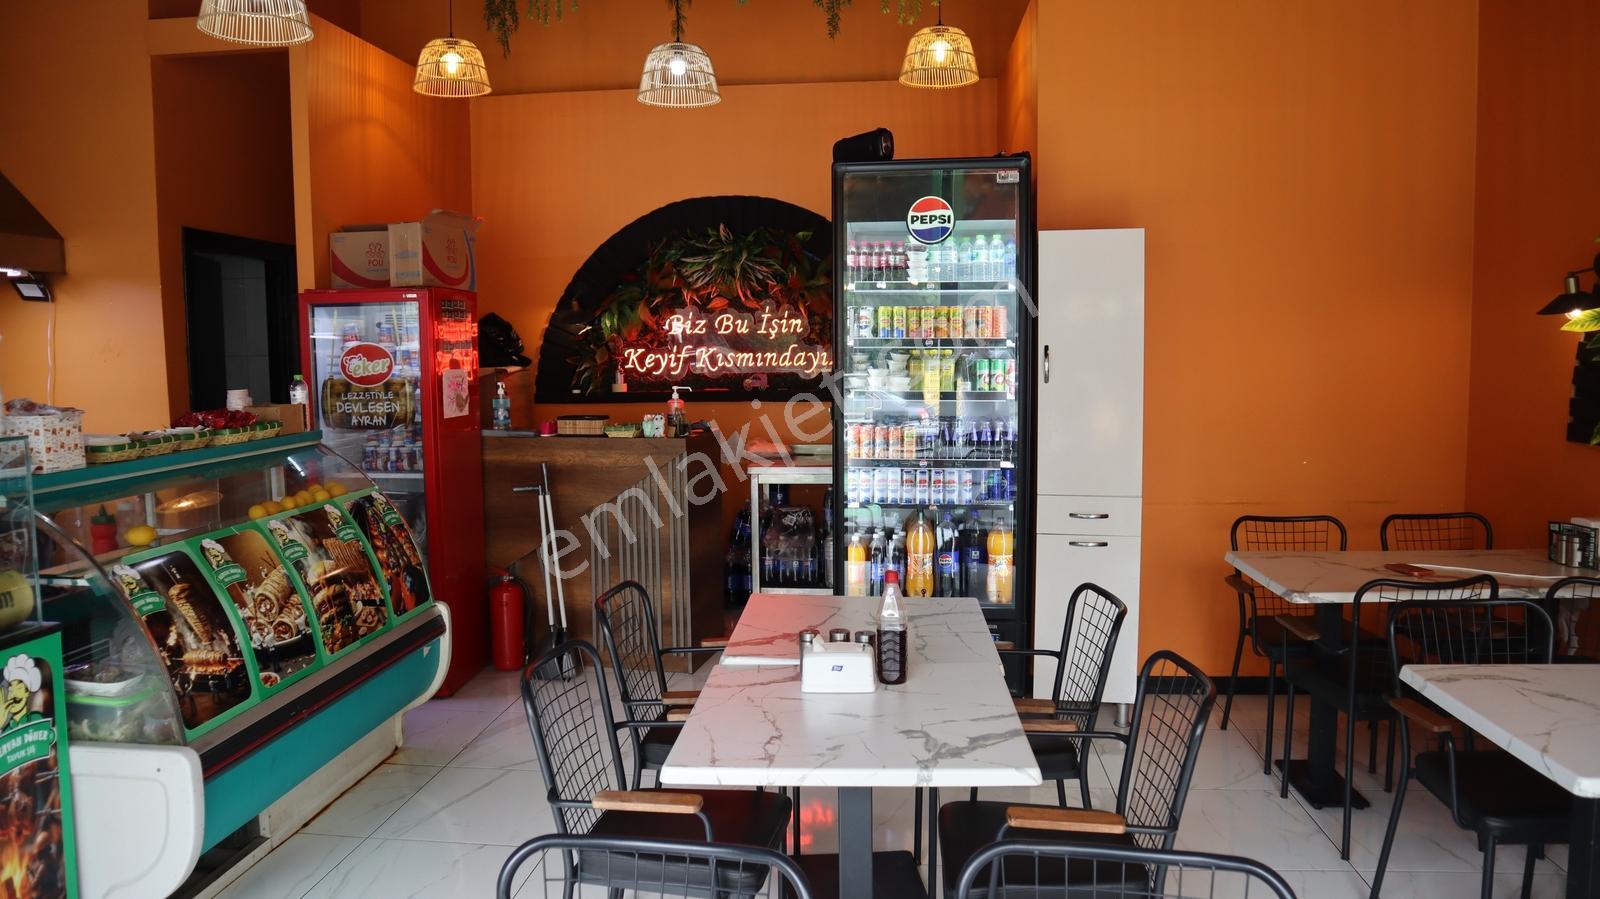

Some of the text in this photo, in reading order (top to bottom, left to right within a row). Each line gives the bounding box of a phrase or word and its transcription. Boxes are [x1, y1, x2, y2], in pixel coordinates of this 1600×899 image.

[910, 214, 951, 225] PEPSI
[666, 306, 804, 340] Biz Bu İşin
[352, 357, 390, 377] eker
[624, 344, 692, 376] Keyif
[351, 415, 387, 426] AYRAN
